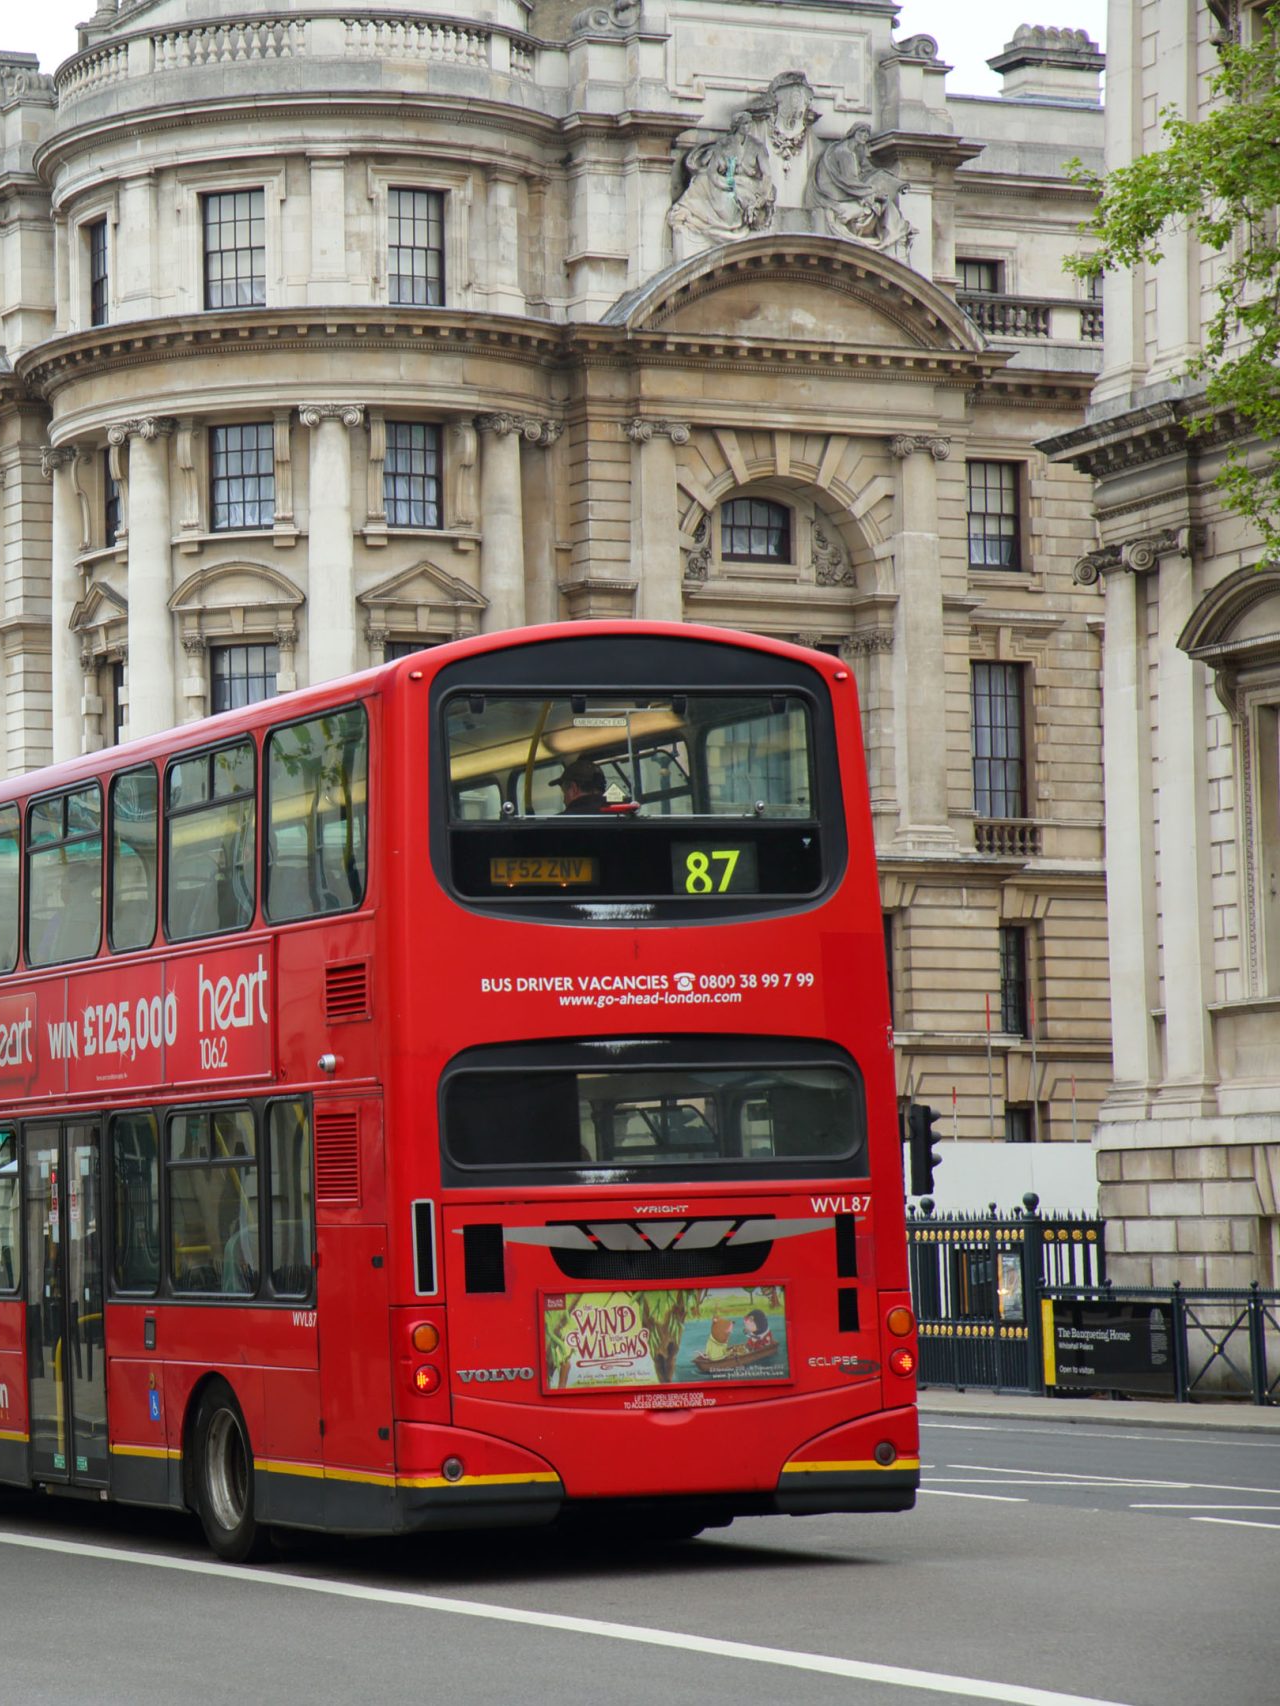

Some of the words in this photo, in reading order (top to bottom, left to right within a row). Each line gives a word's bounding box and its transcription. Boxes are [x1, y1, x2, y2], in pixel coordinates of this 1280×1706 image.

[493, 861, 542, 879] LF52
[547, 860, 585, 877] ZNV
[685, 850, 740, 893] 87
[481, 977, 513, 992] BUS
[516, 977, 574, 992] DRIVER
[578, 975, 669, 990] VACANCIES
[699, 974, 736, 989] 0800
[739, 974, 758, 988] 38
[761, 973, 780, 988] 99
[783, 973, 792, 987] 7
[796, 972, 814, 987] 99
[198, 953, 268, 1033] heart
[559, 991, 742, 1008] www.go-ahead-london.com
[48, 1021, 79, 1060] WIN
[83, 991, 177, 1062] £125,000
[199, 1036, 229, 1070] 106.2
[633, 1205, 688, 1214] WRIGHT
[810, 1196, 872, 1213] WVL87
[292, 1311, 317, 1328] WVL87
[572, 1305, 636, 1336] WIND
[566, 1328, 649, 1359] WILLOWS
[1057, 1327, 1071, 1338] The
[1071, 1328, 1110, 1342] Banqueting
[1109, 1329, 1131, 1341] House
[808, 1356, 859, 1367] ECLIPSE
[1059, 1365, 1072, 1374] Open
[456, 1367, 535, 1382] VOLVO
